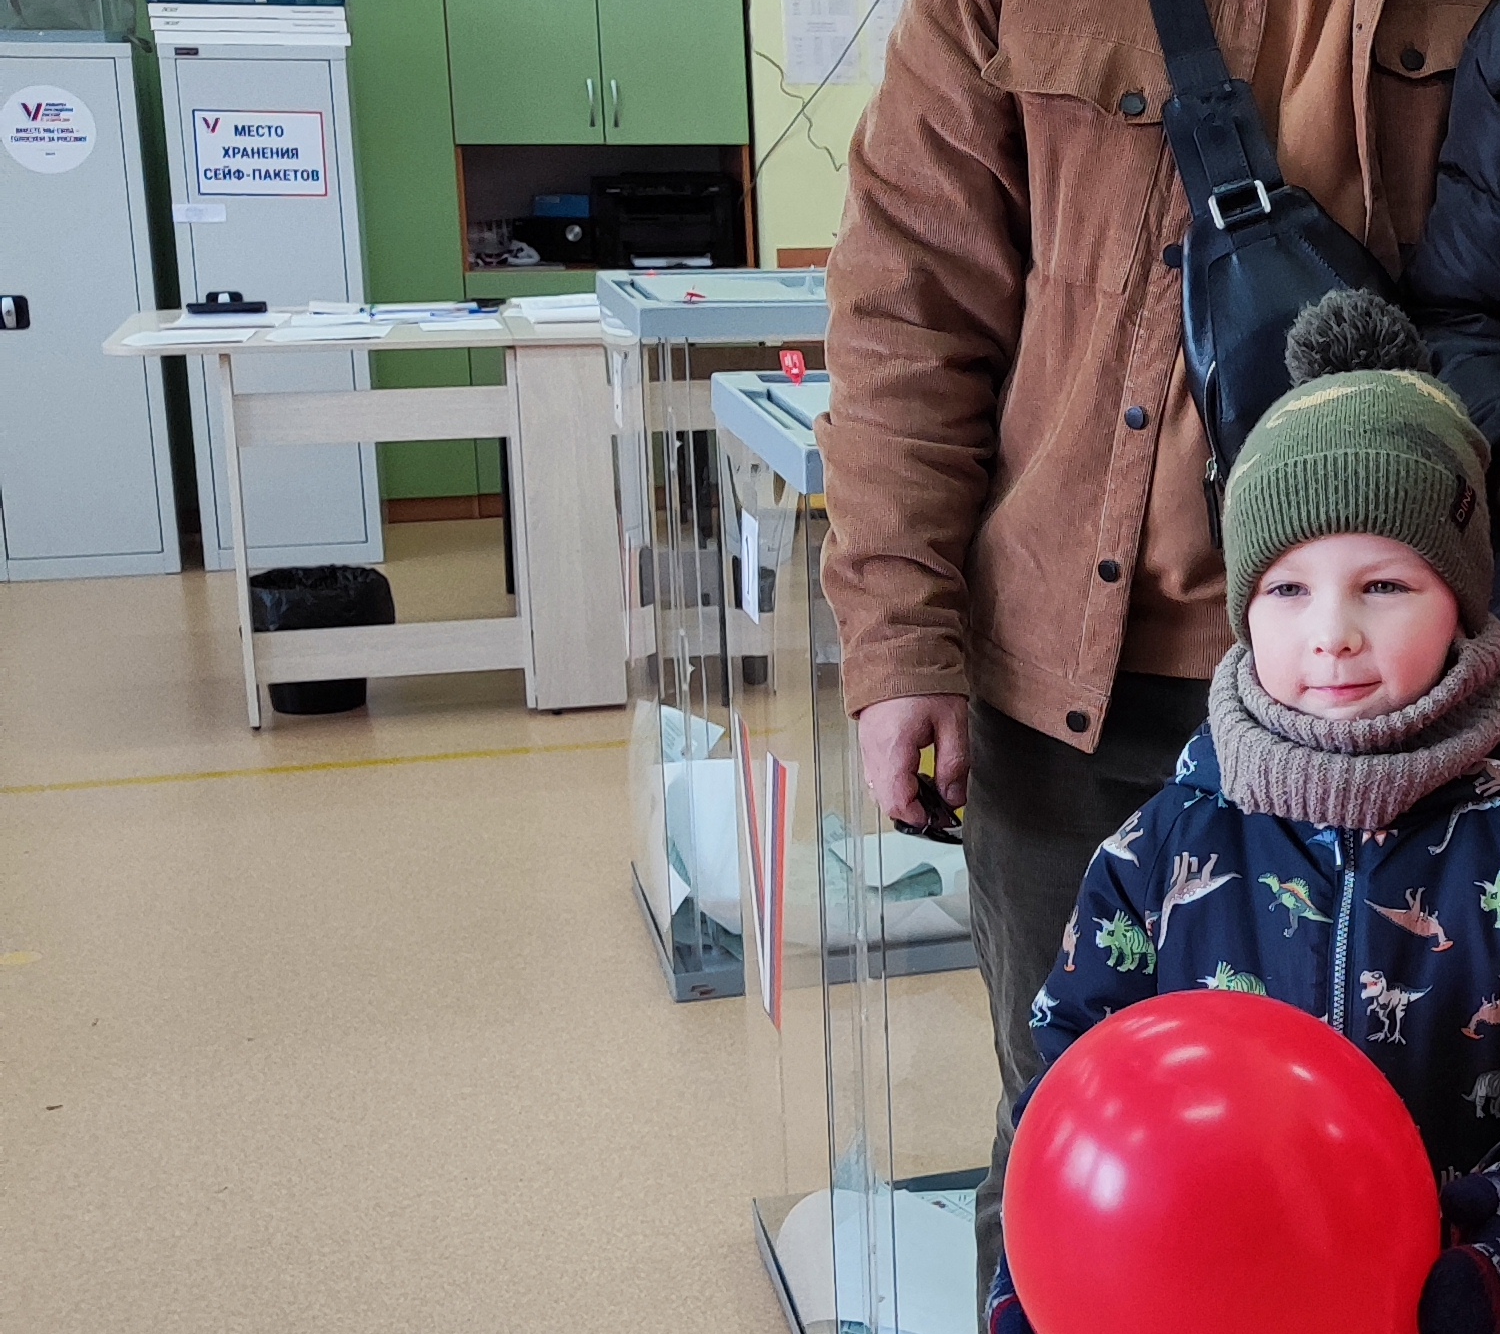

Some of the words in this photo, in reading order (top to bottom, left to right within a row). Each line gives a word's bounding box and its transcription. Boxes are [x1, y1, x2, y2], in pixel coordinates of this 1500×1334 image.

[233, 124, 285, 138] МЕСТО
[221, 146, 299, 160] ХРАНЕНИЯ
[203, 165, 320, 182] СЕЙФ-ПАКЕТОВ
